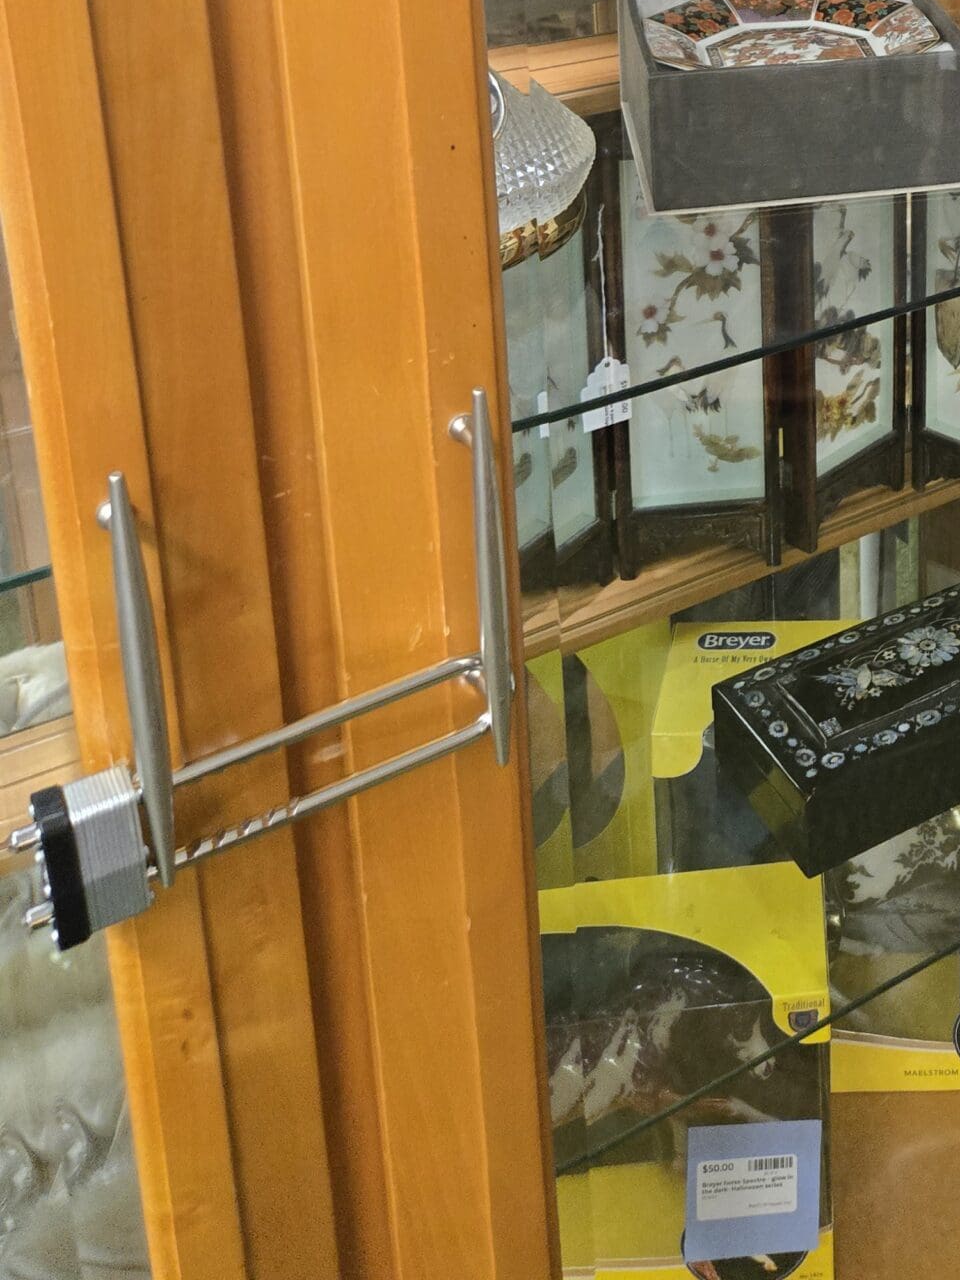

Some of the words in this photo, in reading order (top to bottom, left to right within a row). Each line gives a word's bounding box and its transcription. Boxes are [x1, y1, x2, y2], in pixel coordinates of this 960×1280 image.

[704, 634, 771, 650] Breyer
[904, 1069, 959, 1077] MAELSTROM
[702, 1163, 734, 1173] $50.00
